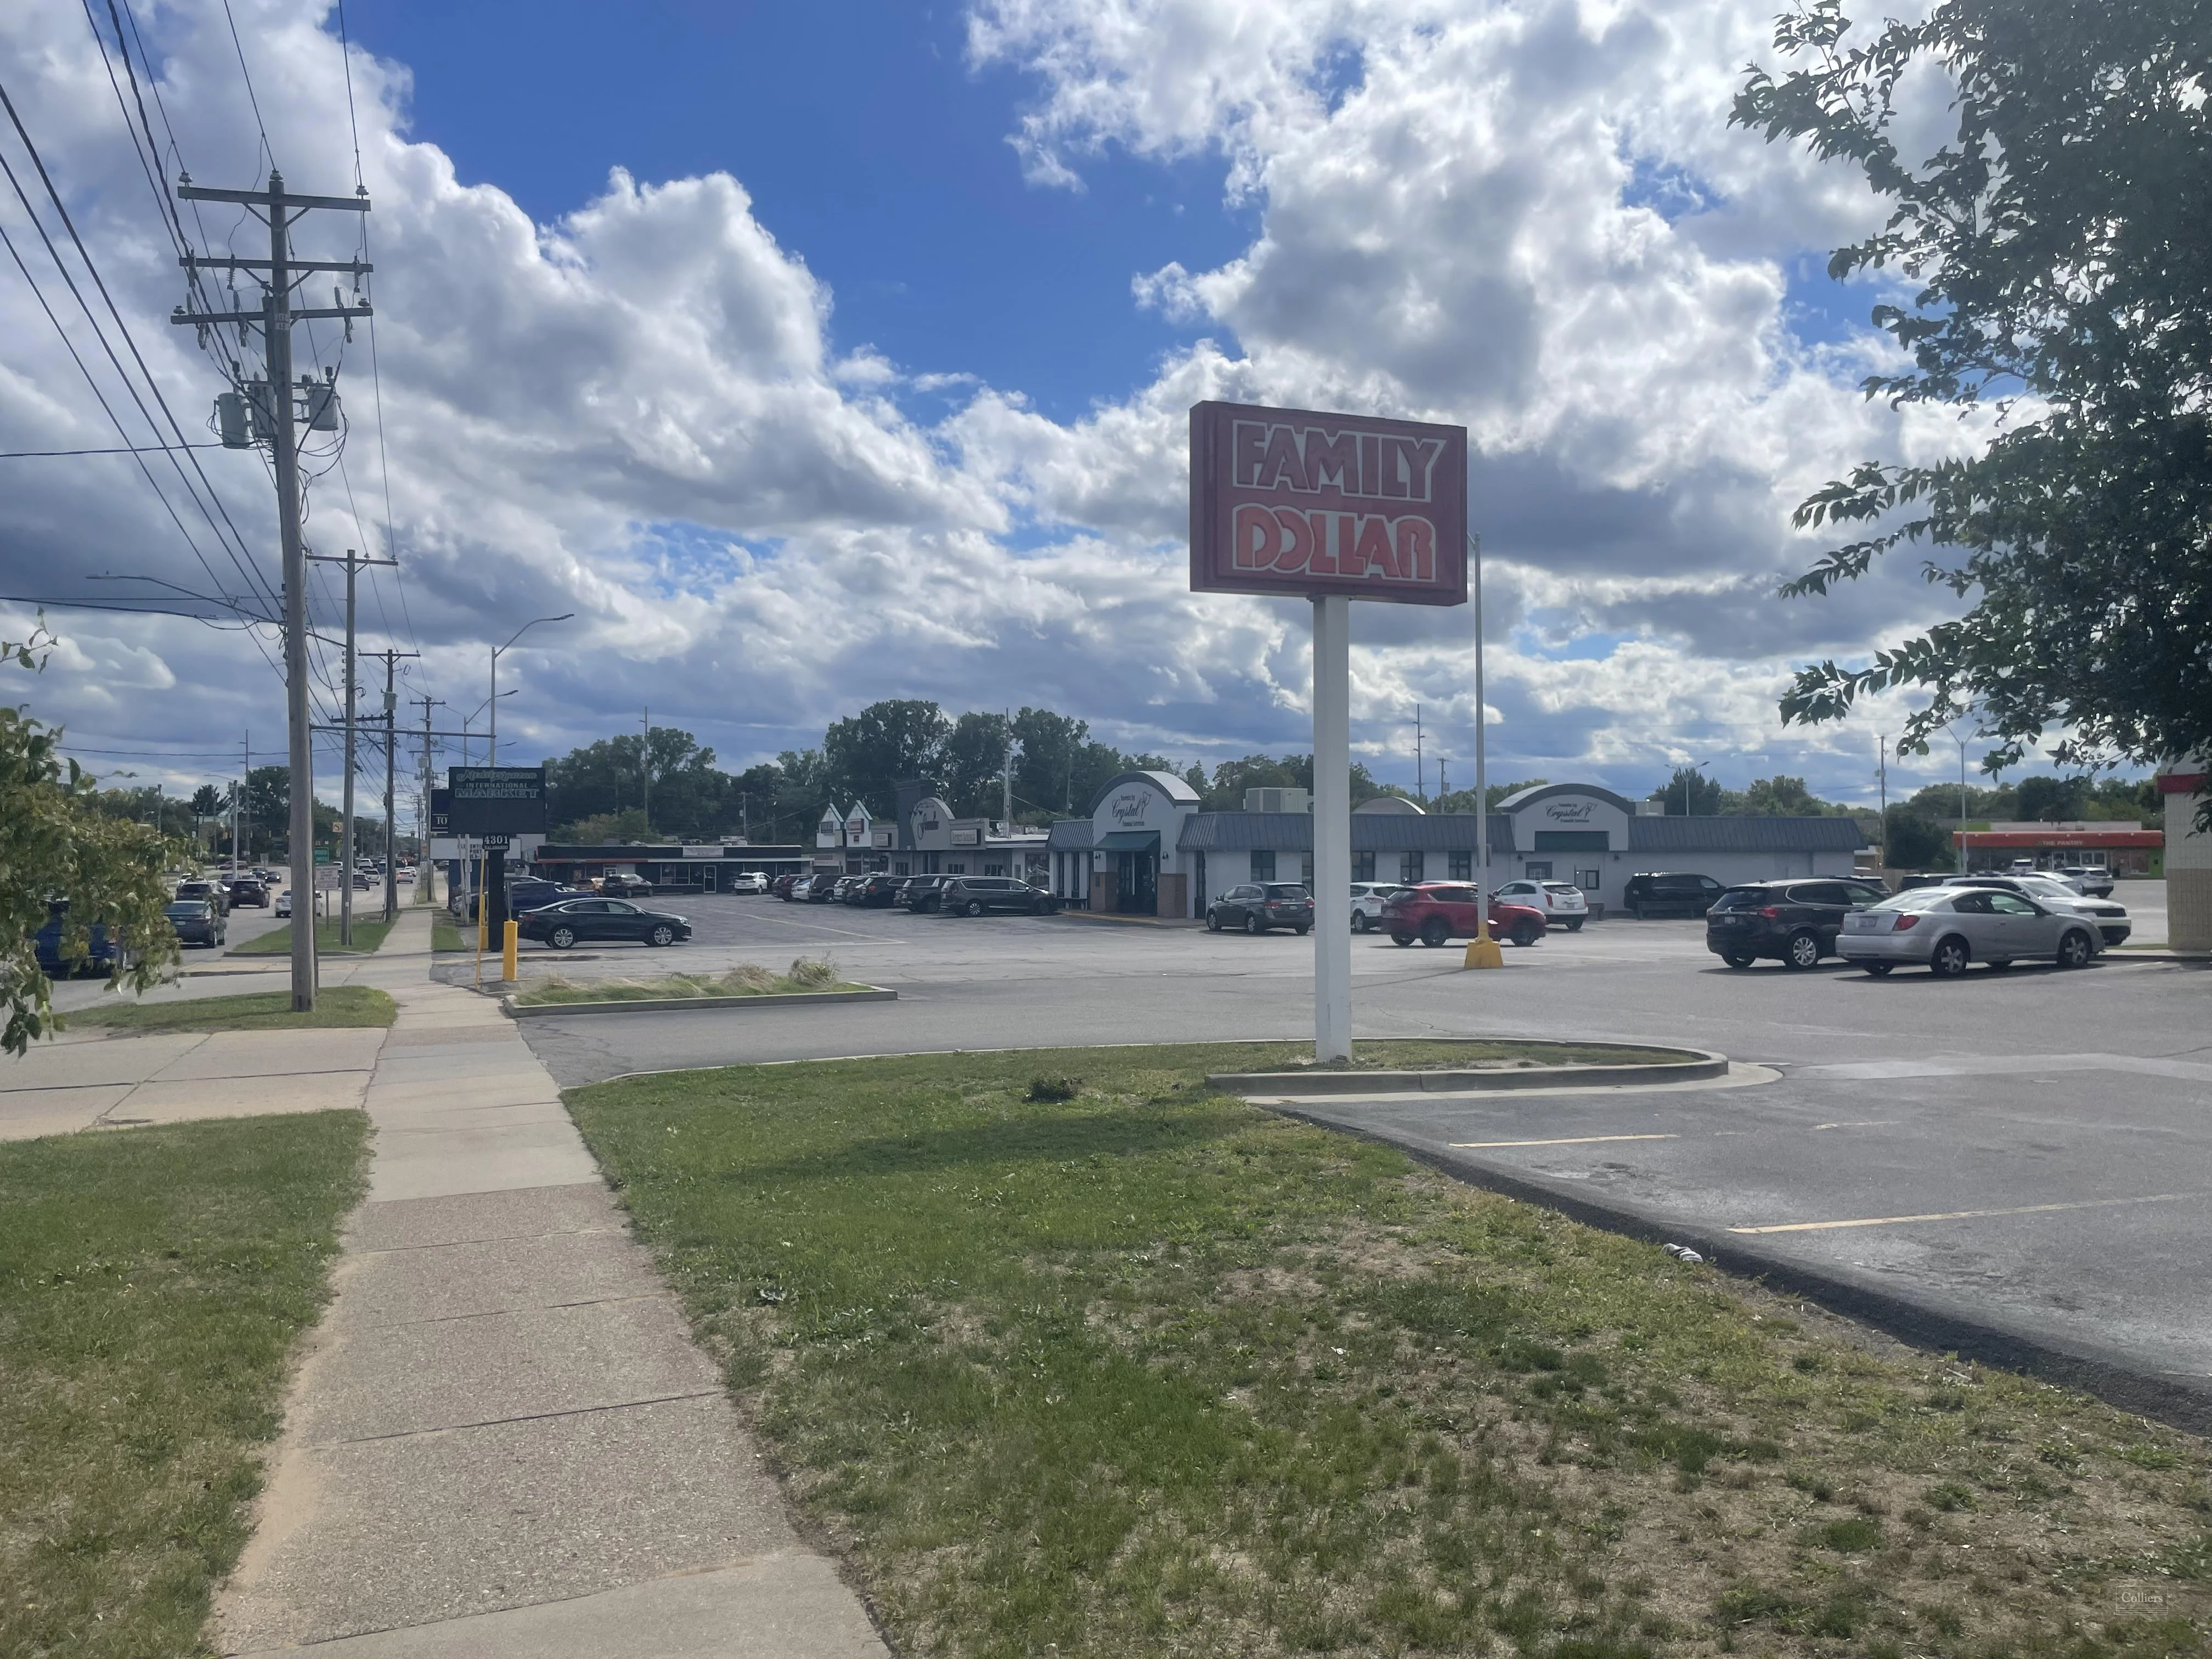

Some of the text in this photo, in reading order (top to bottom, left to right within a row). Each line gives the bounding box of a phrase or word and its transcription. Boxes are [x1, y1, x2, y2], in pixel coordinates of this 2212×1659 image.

[1233, 420, 1447, 503] FAMILY
[1233, 503, 1436, 583] DOLLAR
[455, 788, 540, 798] MARKET
[1111, 798, 1143, 824] Crystal
[1545, 805, 1587, 821] Crystal
[484, 835, 509, 844] 4301
